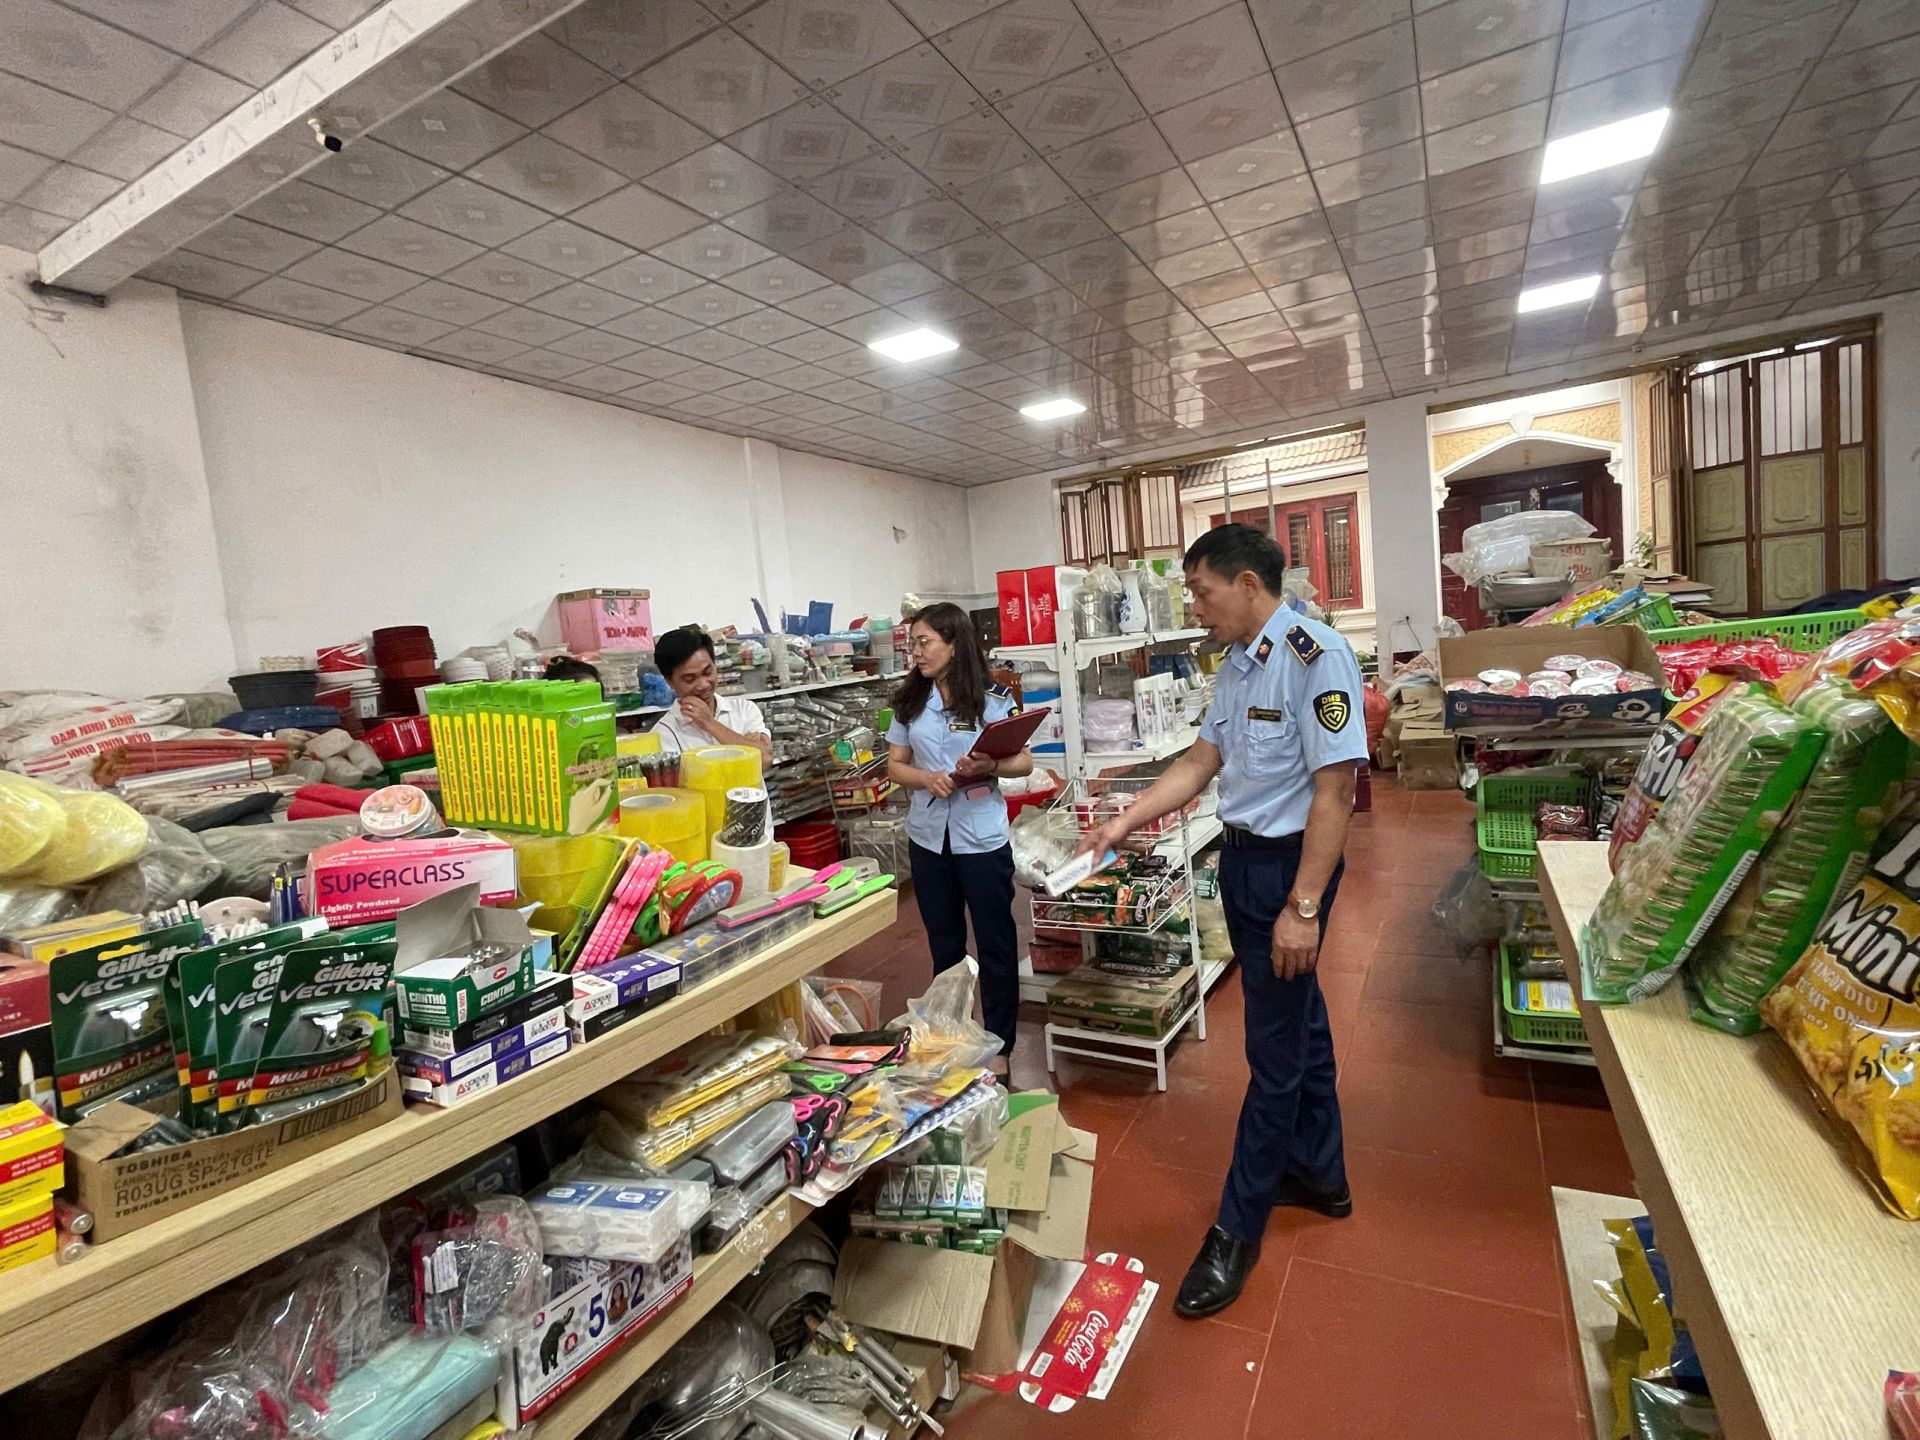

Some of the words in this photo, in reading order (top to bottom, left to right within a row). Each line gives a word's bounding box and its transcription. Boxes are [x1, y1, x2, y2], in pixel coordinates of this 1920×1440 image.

[1322, 694, 1341, 704] DMS
[79, 721, 107, 736] NINH
[321, 902, 354, 914] Lightly
[357, 897, 400, 909] Powdered
[342, 909, 370, 920] MEDICAL
[57, 963, 170, 1004] VECTO
[314, 962, 388, 984] Gillette
[280, 977, 385, 1004] VECTOR
[78, 1063, 123, 1084] MUA
[269, 1072, 309, 1085] MUA
[116, 1150, 193, 1176] TOSHIBA
[114, 1195, 170, 1218] TOSHIBA
[170, 1177, 224, 1199] BATTERY
[116, 1176, 182, 1206] R03UG
[630, 1266, 645, 1310] 2
[1063, 1310, 1110, 1373] Coca-Cola
